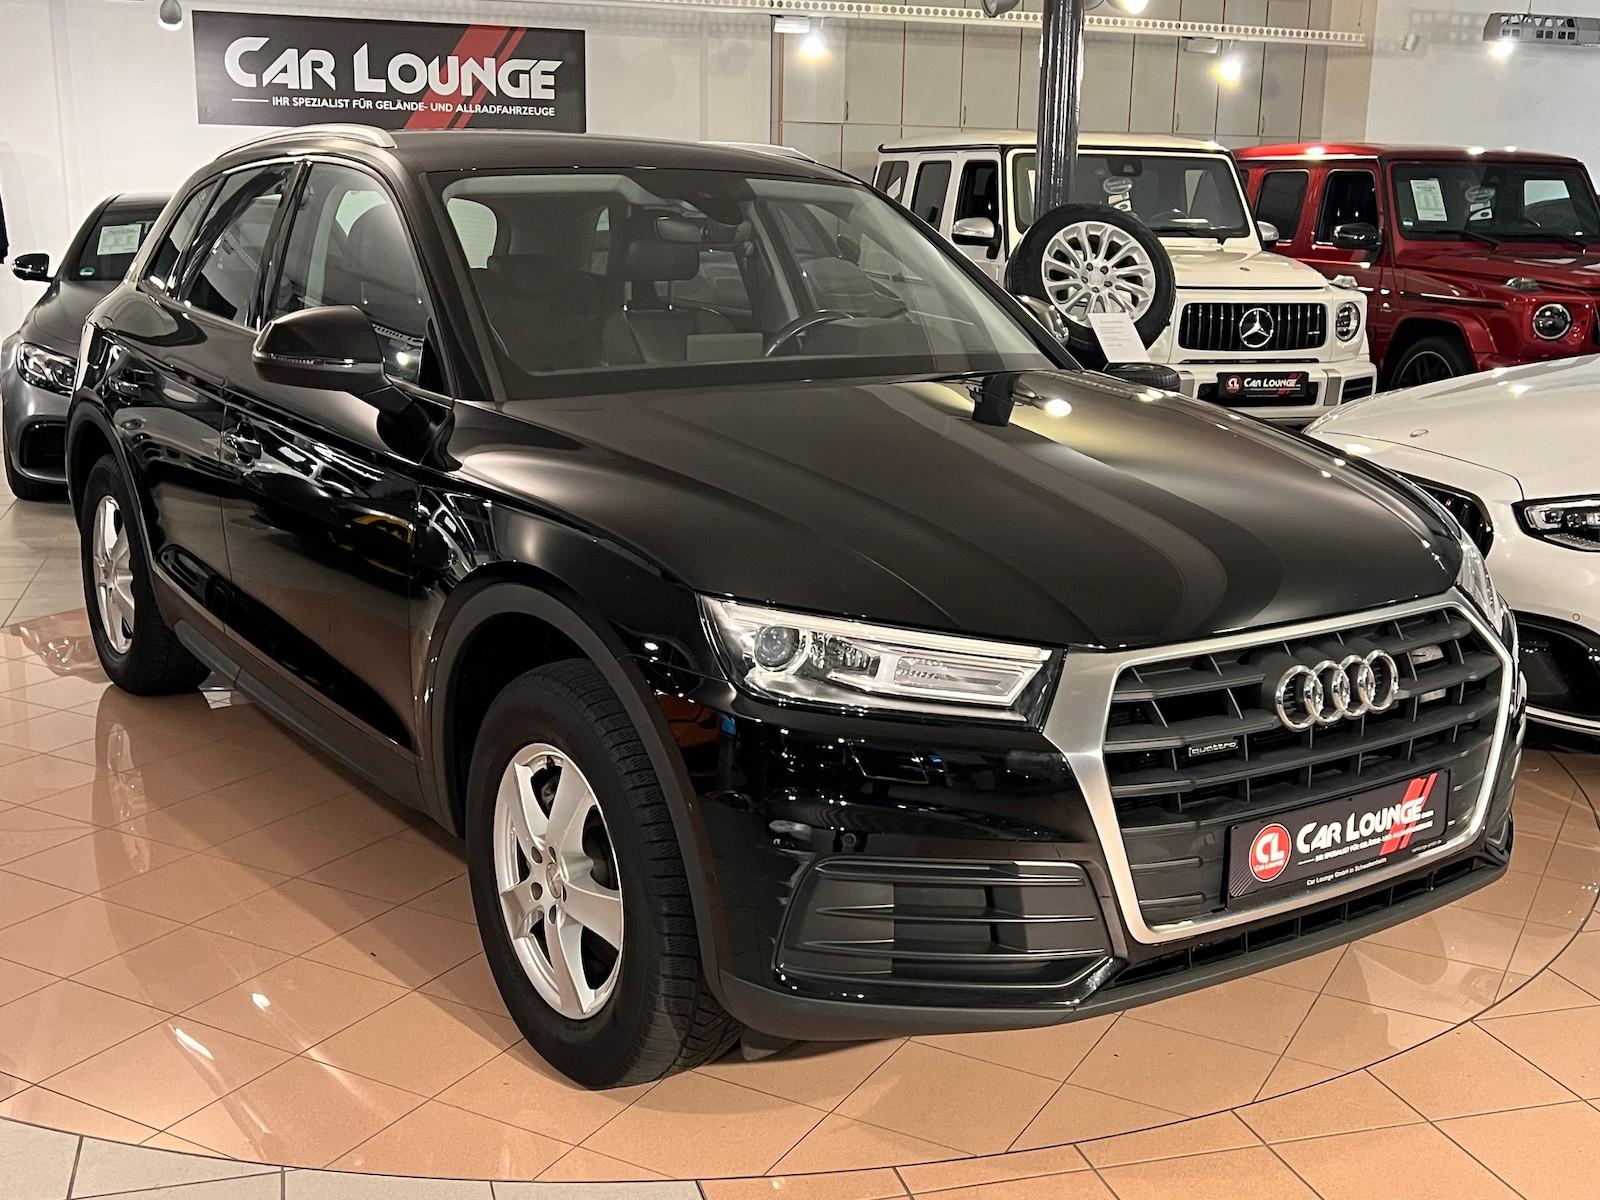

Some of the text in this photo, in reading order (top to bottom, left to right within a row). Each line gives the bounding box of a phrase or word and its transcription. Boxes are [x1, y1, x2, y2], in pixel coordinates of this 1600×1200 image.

[224, 36, 563, 100] CAR LOUNGE
[272, 96, 555, 117] IHR SPEZIALIST FÜR GELÄNDE- UND ALLRADFAHRZEUGE
[1191, 741, 1237, 755] quattro
[1296, 821, 1342, 854] CAR
[1345, 797, 1425, 842] LOUNGE
[1255, 832, 1285, 864] CL
